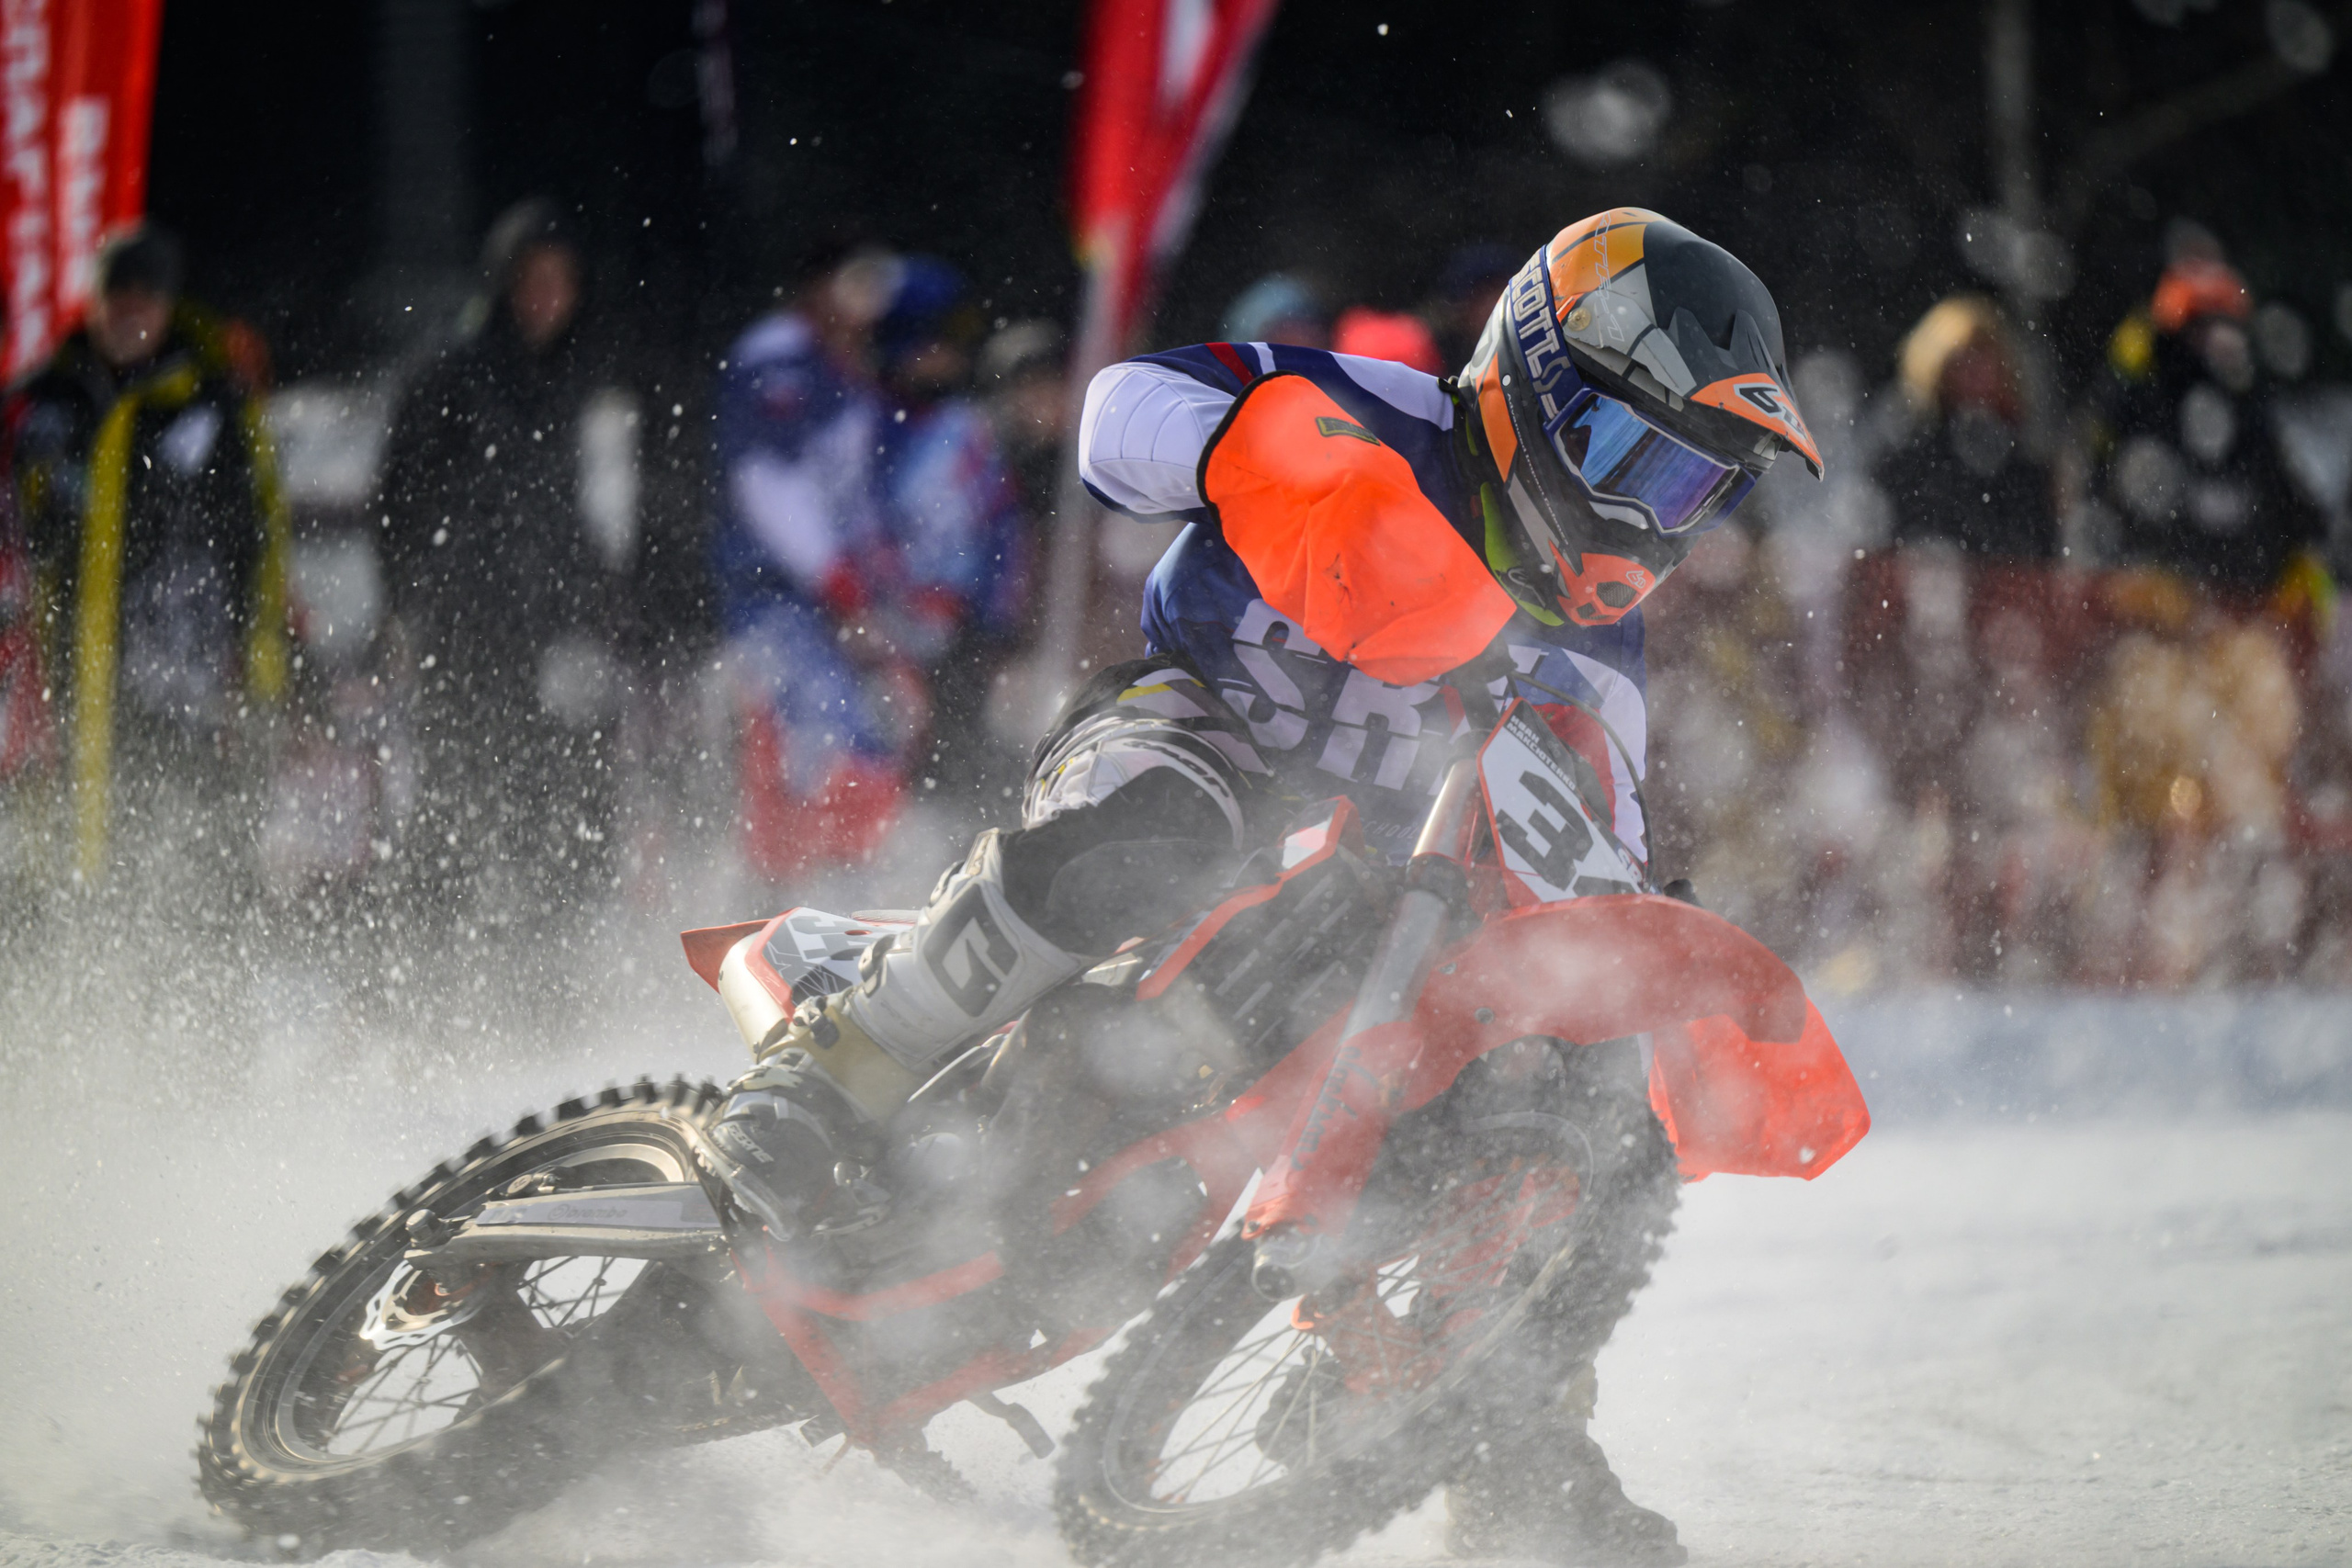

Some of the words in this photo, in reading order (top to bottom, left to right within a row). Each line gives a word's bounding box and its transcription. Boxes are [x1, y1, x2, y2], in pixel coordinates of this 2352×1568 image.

[1510, 253, 1561, 378] SCOTT
[1360, 817, 1420, 840] CHOOL
[1495, 770, 1641, 897] 3
